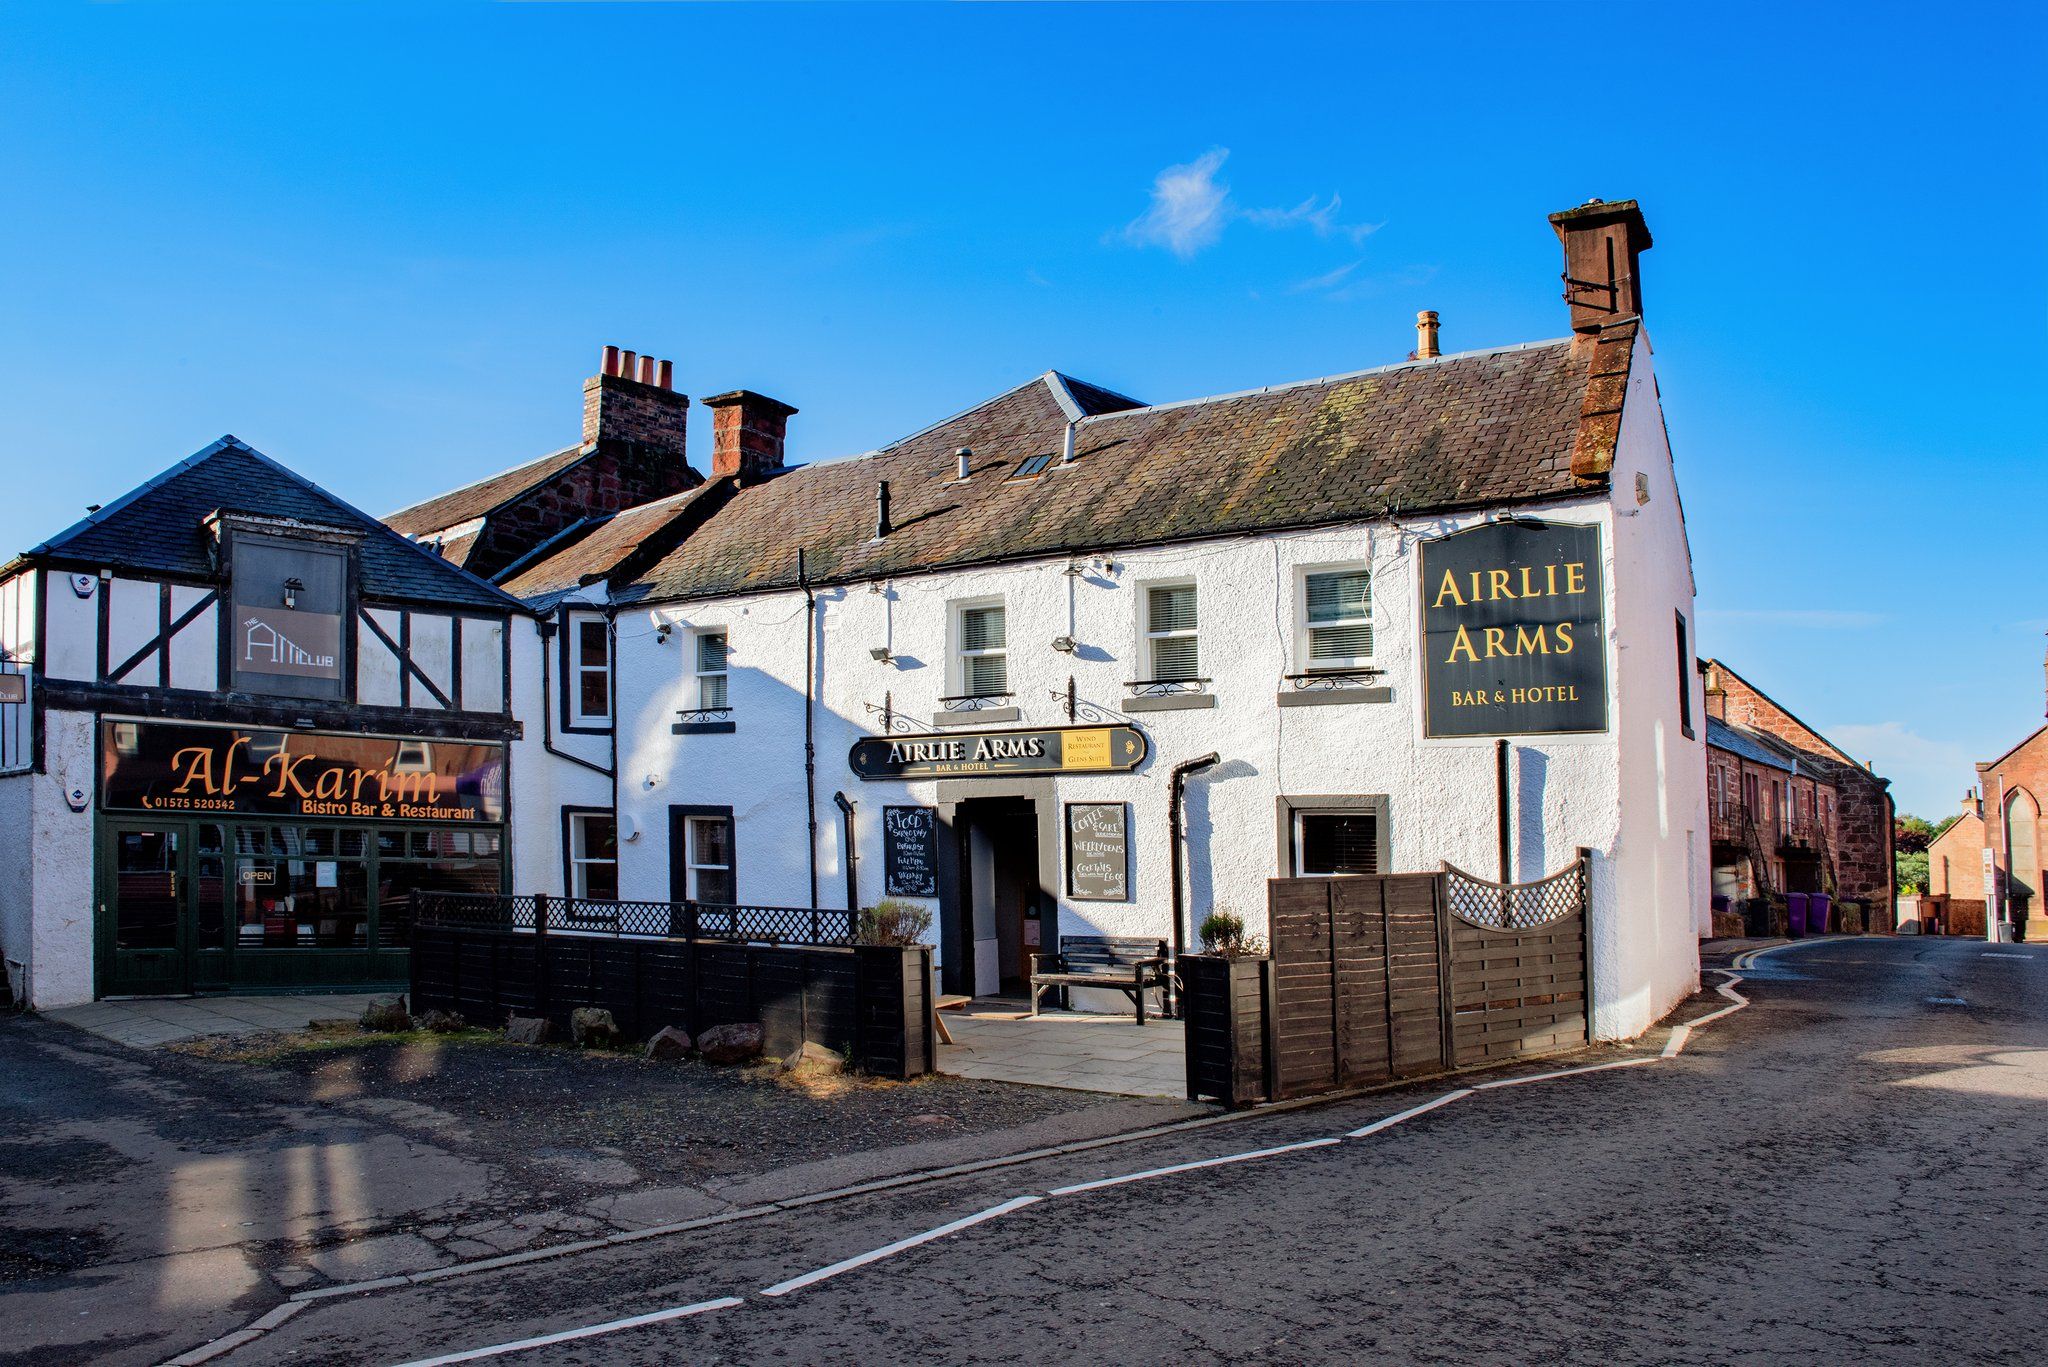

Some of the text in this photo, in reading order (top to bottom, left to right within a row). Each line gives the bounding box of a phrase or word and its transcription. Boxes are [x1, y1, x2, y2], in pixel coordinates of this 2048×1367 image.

[1432, 562, 1586, 608] AIRLIE
[244, 617, 259, 628] THE
[1444, 622, 1575, 664] ARMS
[1452, 686, 1579, 707] BAR & HOTEL
[1075, 735, 1097, 743] WYND
[887, 737, 1040, 764] AIRLIE ARMS
[172, 737, 441, 804] Al-Karim
[936, 764, 952, 772] BAR
[961, 762, 989, 771] HOTEL
[155, 797, 235, 810] 01575 520342
[302, 800, 476, 820] Bistro Bar & Restaurant
[897, 813, 923, 829] FOOD
[1073, 807, 1105, 833] COFFEE
[242, 871, 273, 881] OPEN
